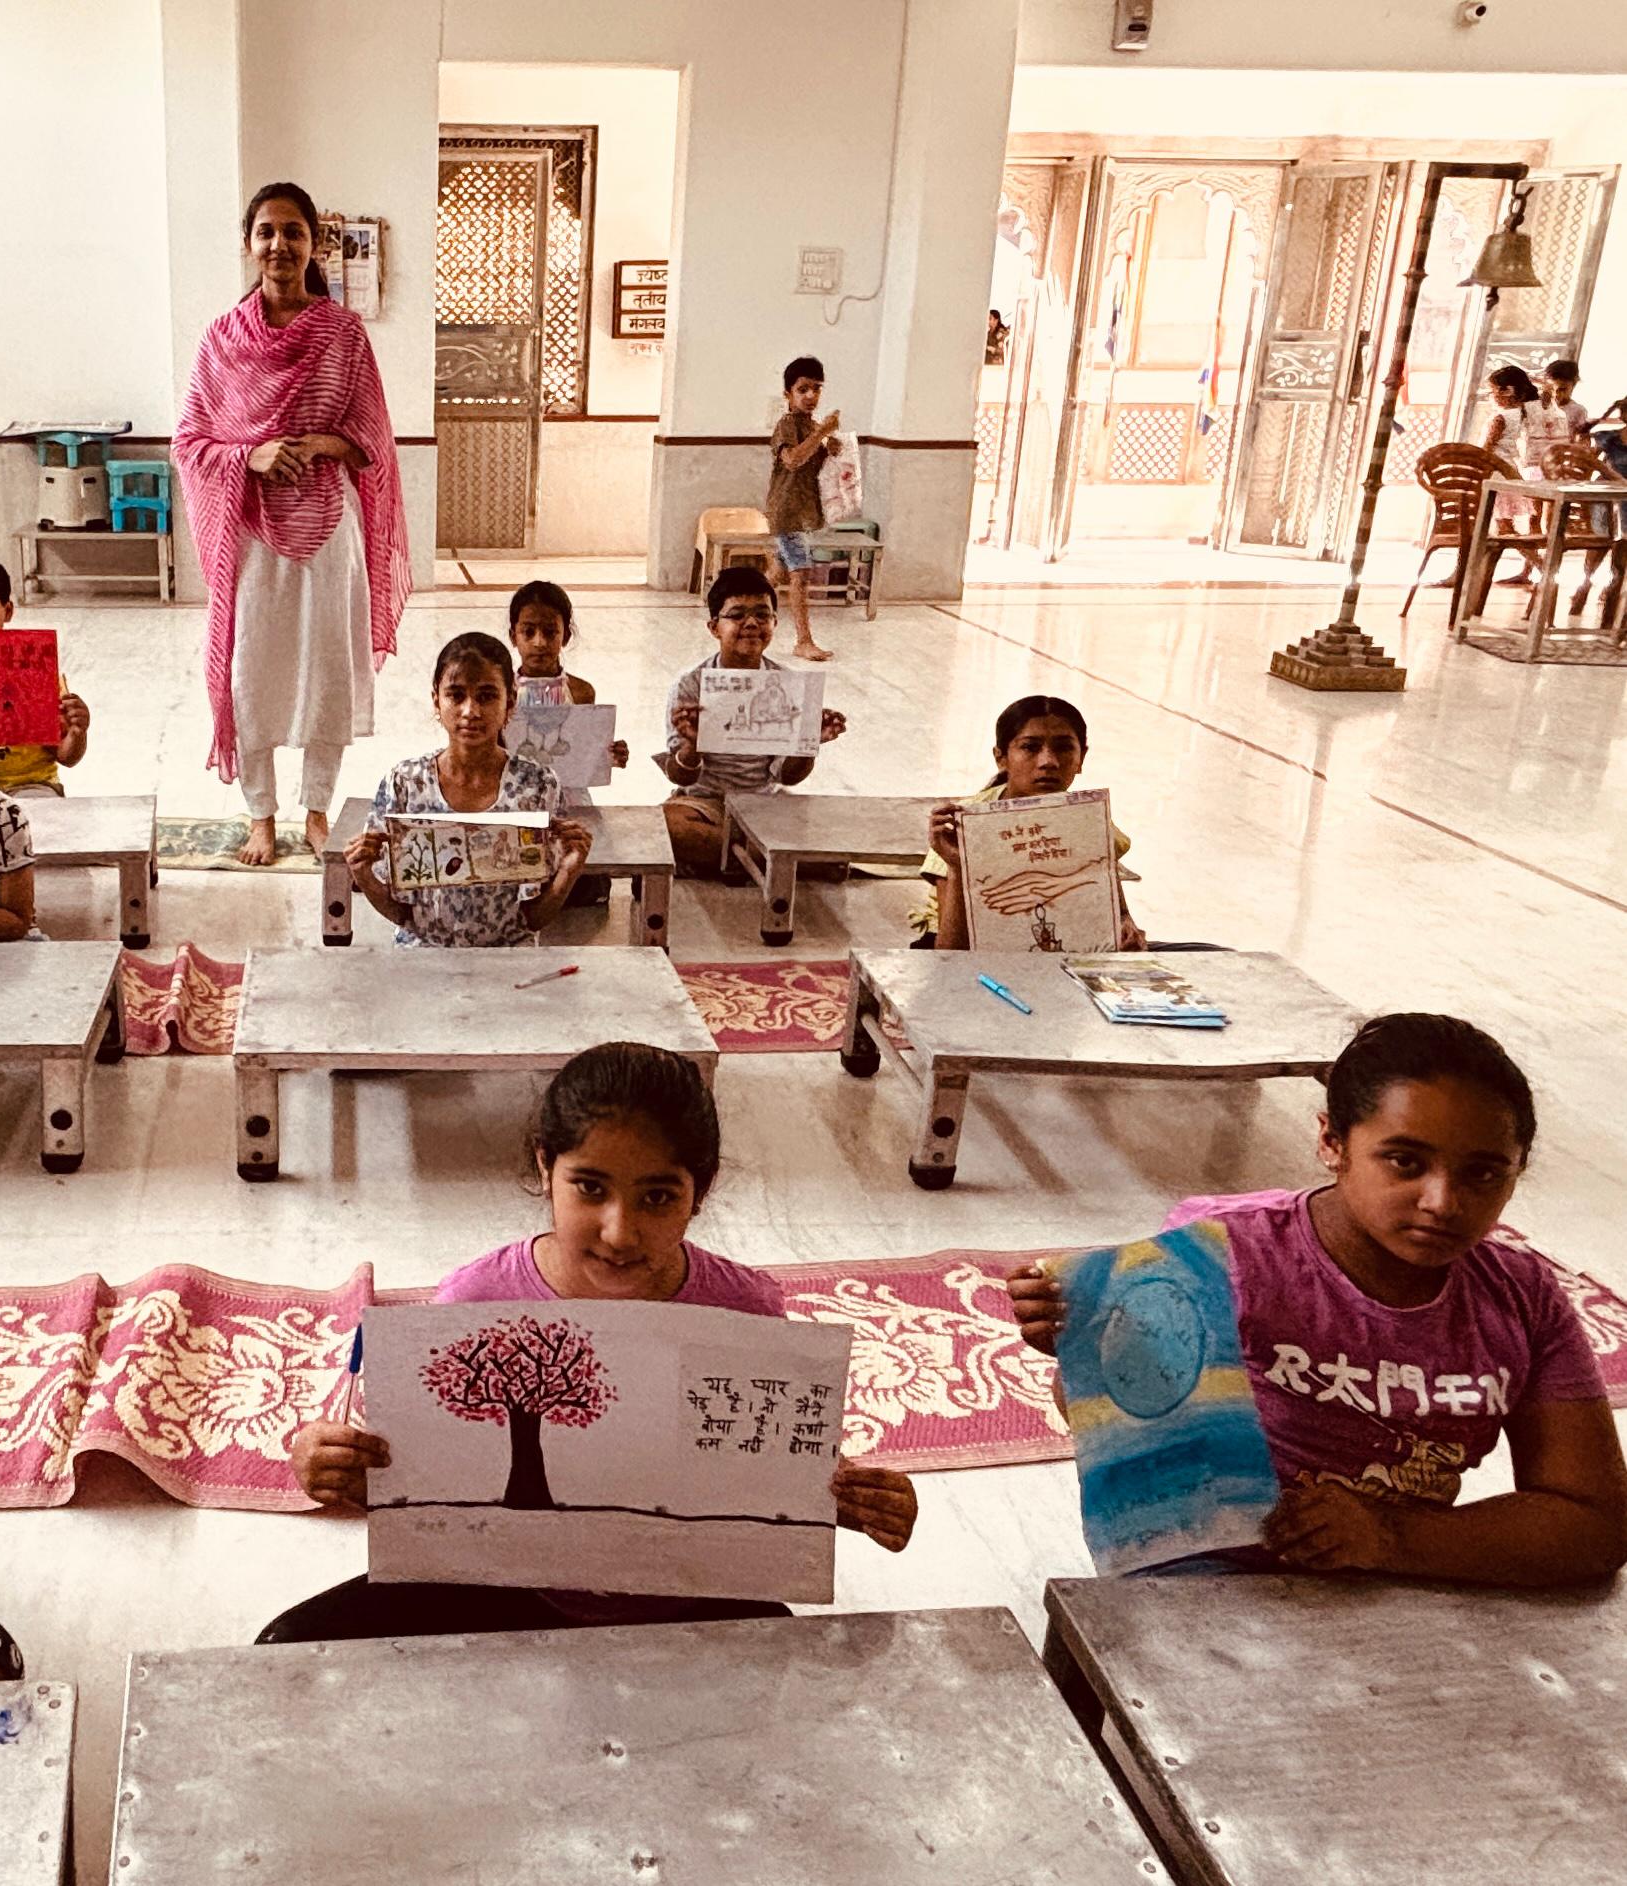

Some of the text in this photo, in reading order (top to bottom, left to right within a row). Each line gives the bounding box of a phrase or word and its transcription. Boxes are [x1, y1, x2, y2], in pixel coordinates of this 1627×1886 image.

[703, 1377, 833, 1399] यह प्यार का
